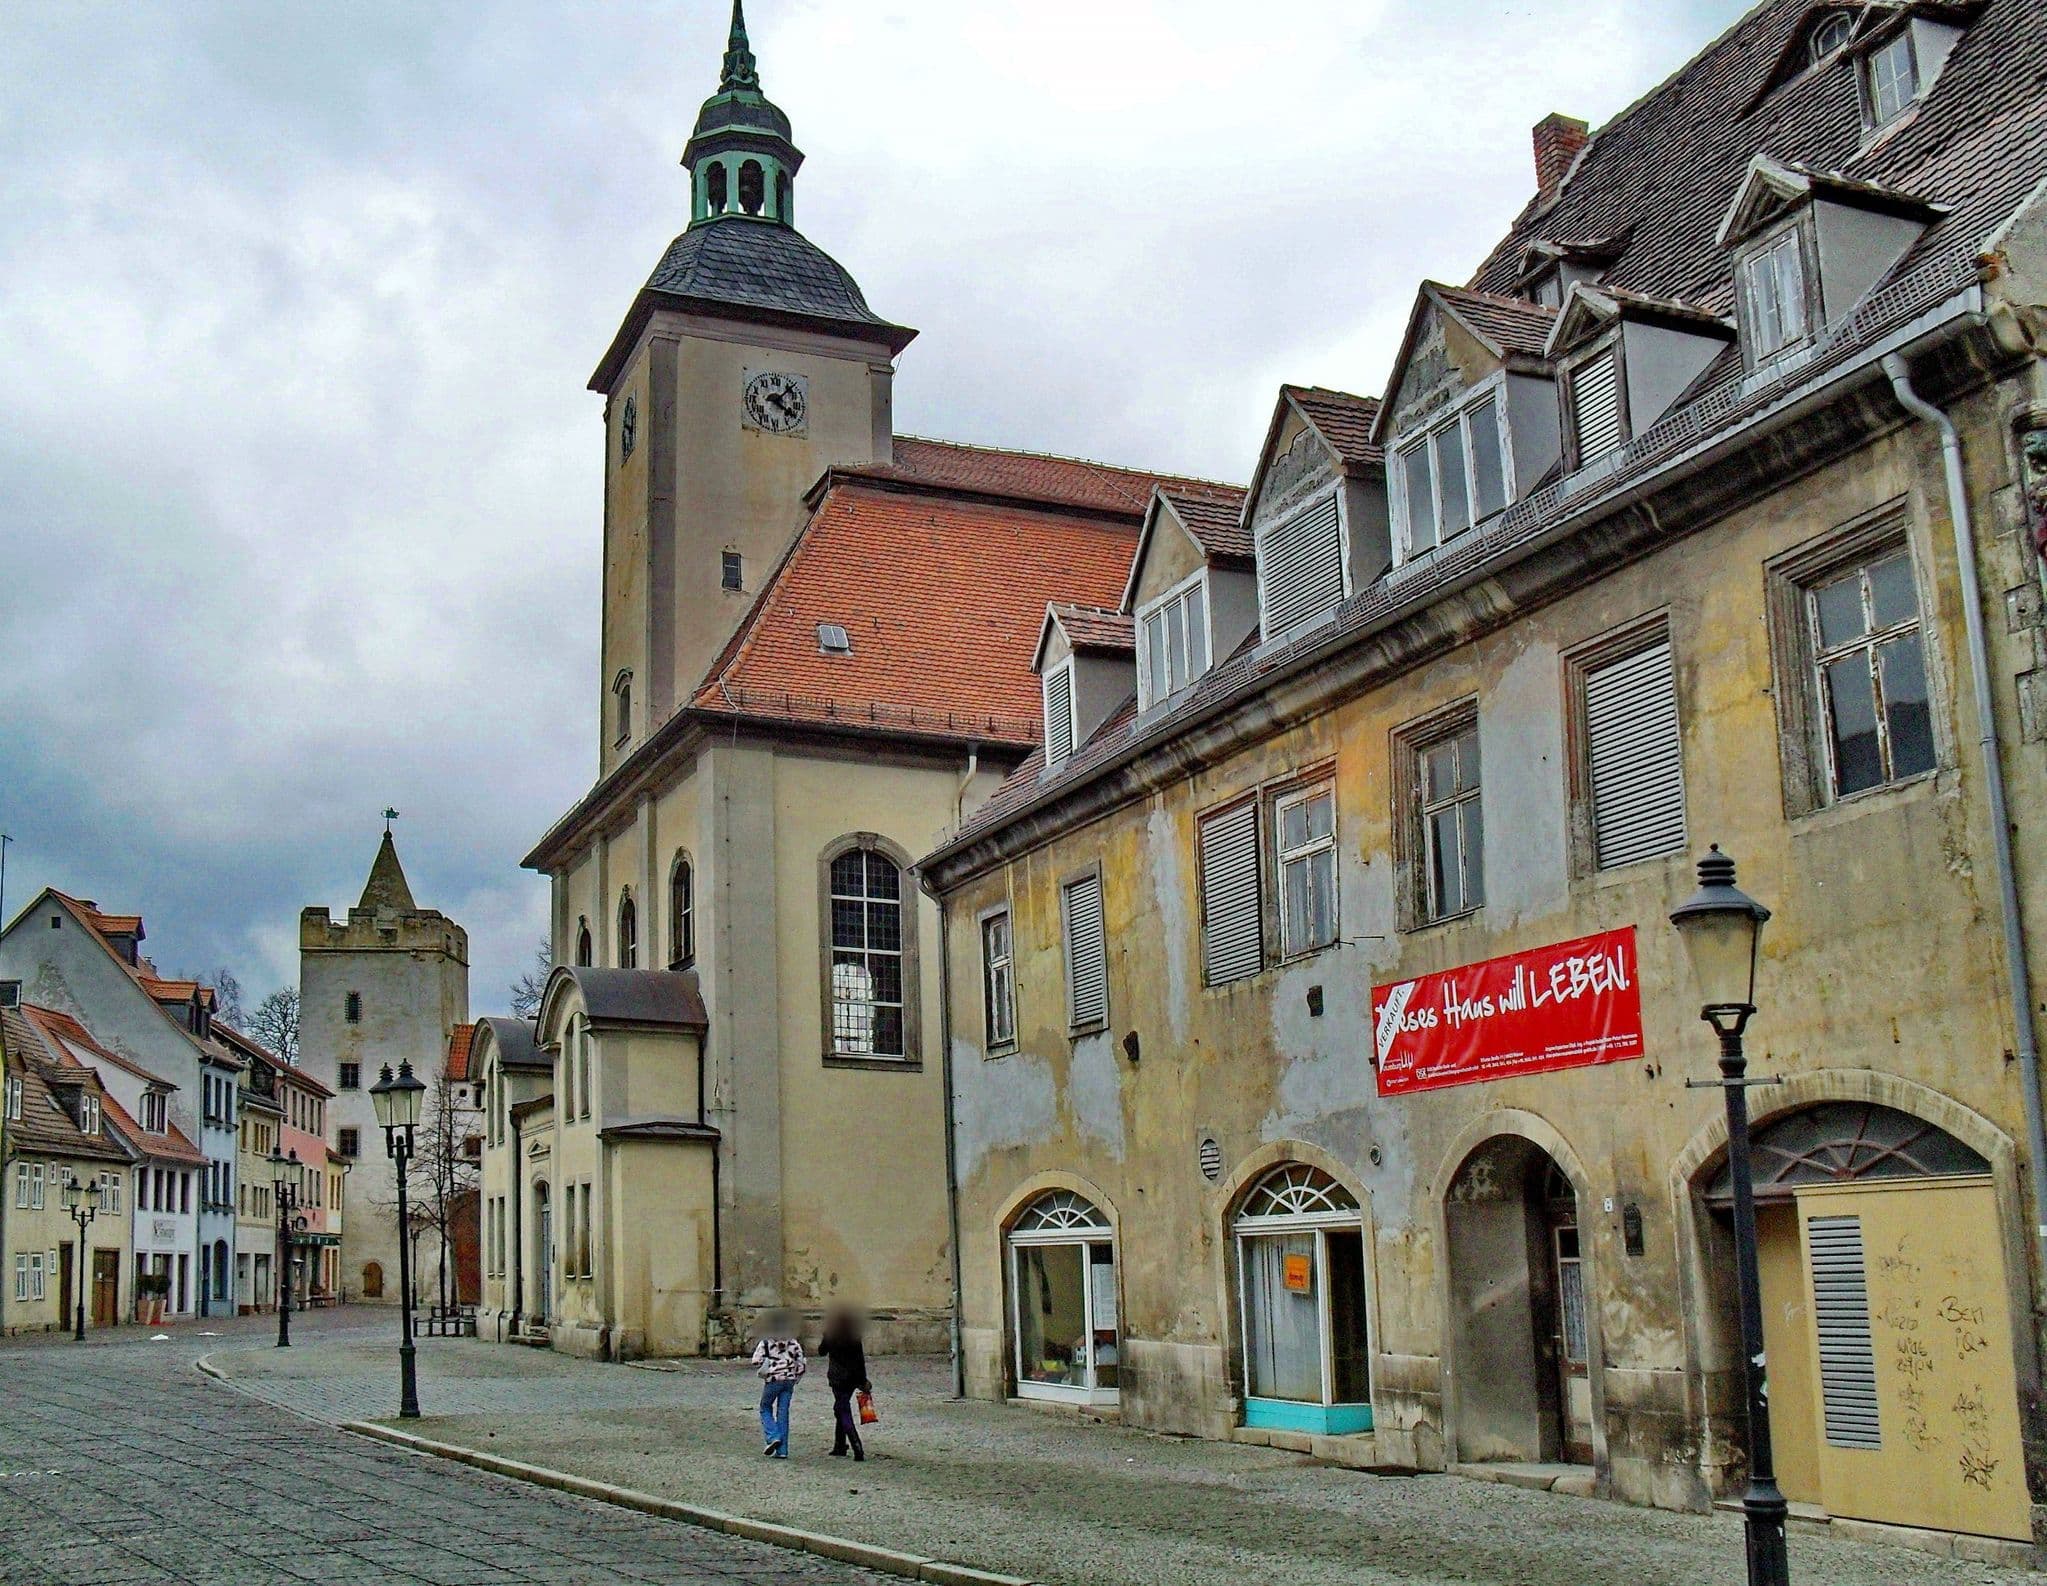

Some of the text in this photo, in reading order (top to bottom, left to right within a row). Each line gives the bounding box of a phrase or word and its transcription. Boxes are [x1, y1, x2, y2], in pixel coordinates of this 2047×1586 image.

[1443, 979, 1495, 1030] Haus
[1499, 964, 1527, 1014] will
[1529, 945, 1631, 1008] LEBEN.
